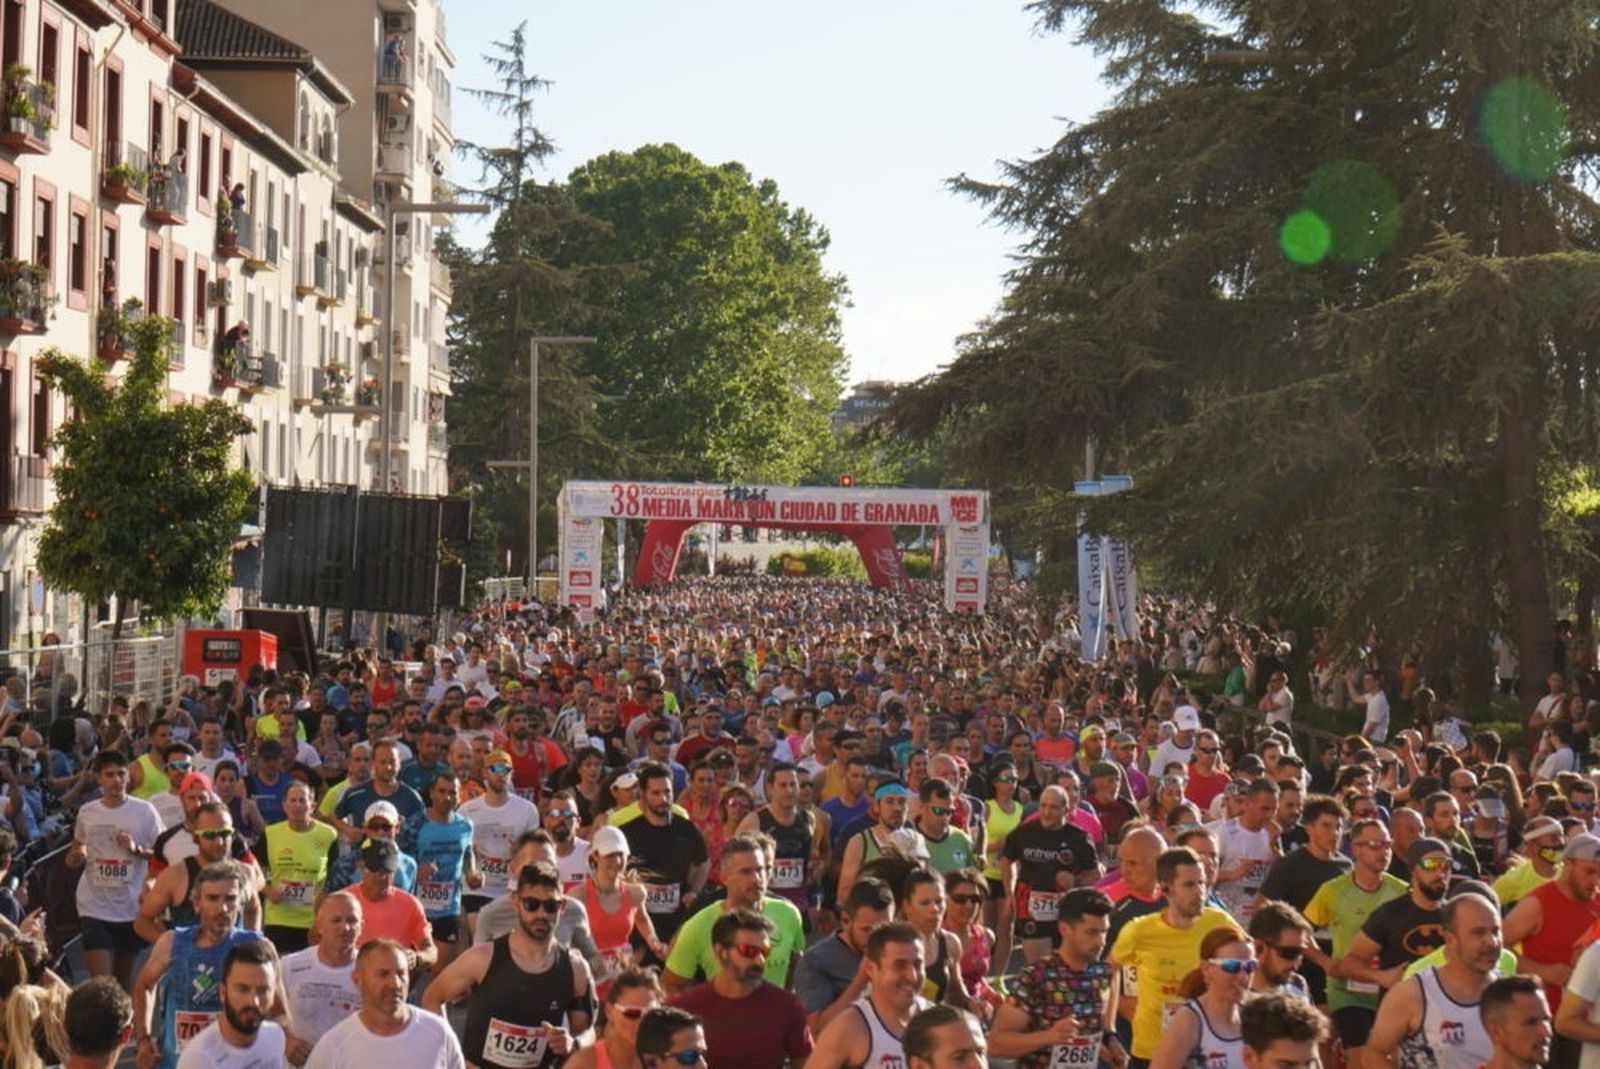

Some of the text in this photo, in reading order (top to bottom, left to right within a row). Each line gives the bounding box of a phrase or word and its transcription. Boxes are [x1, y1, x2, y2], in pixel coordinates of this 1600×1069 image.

[610, 484, 640, 517] 38
[642, 498, 691, 518] MEDIA
[780, 500, 836, 521] CIUDAD
[841, 502, 860, 522] DE
[864, 502, 940, 523] GRANADA
[98, 864, 128, 878] 1088
[494, 1032, 539, 1055] 1624
